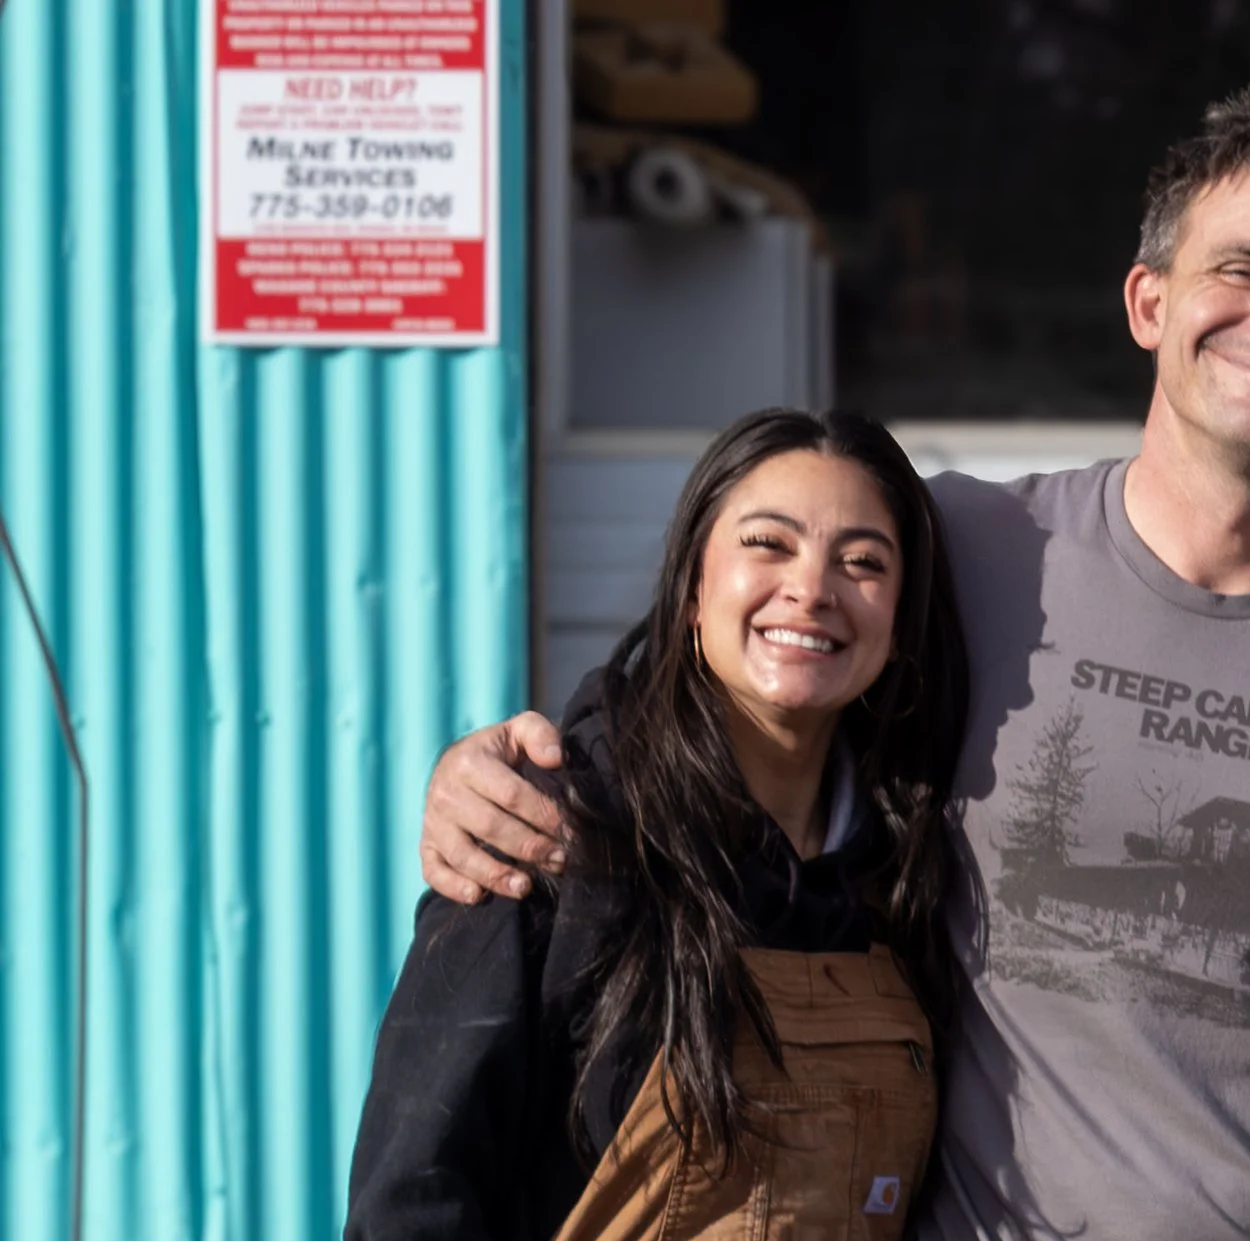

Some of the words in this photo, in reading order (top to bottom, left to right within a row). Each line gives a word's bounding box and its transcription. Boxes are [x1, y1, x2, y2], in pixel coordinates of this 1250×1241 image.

[284, 77, 343, 100] NEED
[349, 78, 418, 101] HELP?
[247, 137, 335, 160] MILNE
[348, 136, 455, 160] TOWING
[284, 164, 415, 187] SERVICES
[1070, 658, 1192, 710] STEEP
